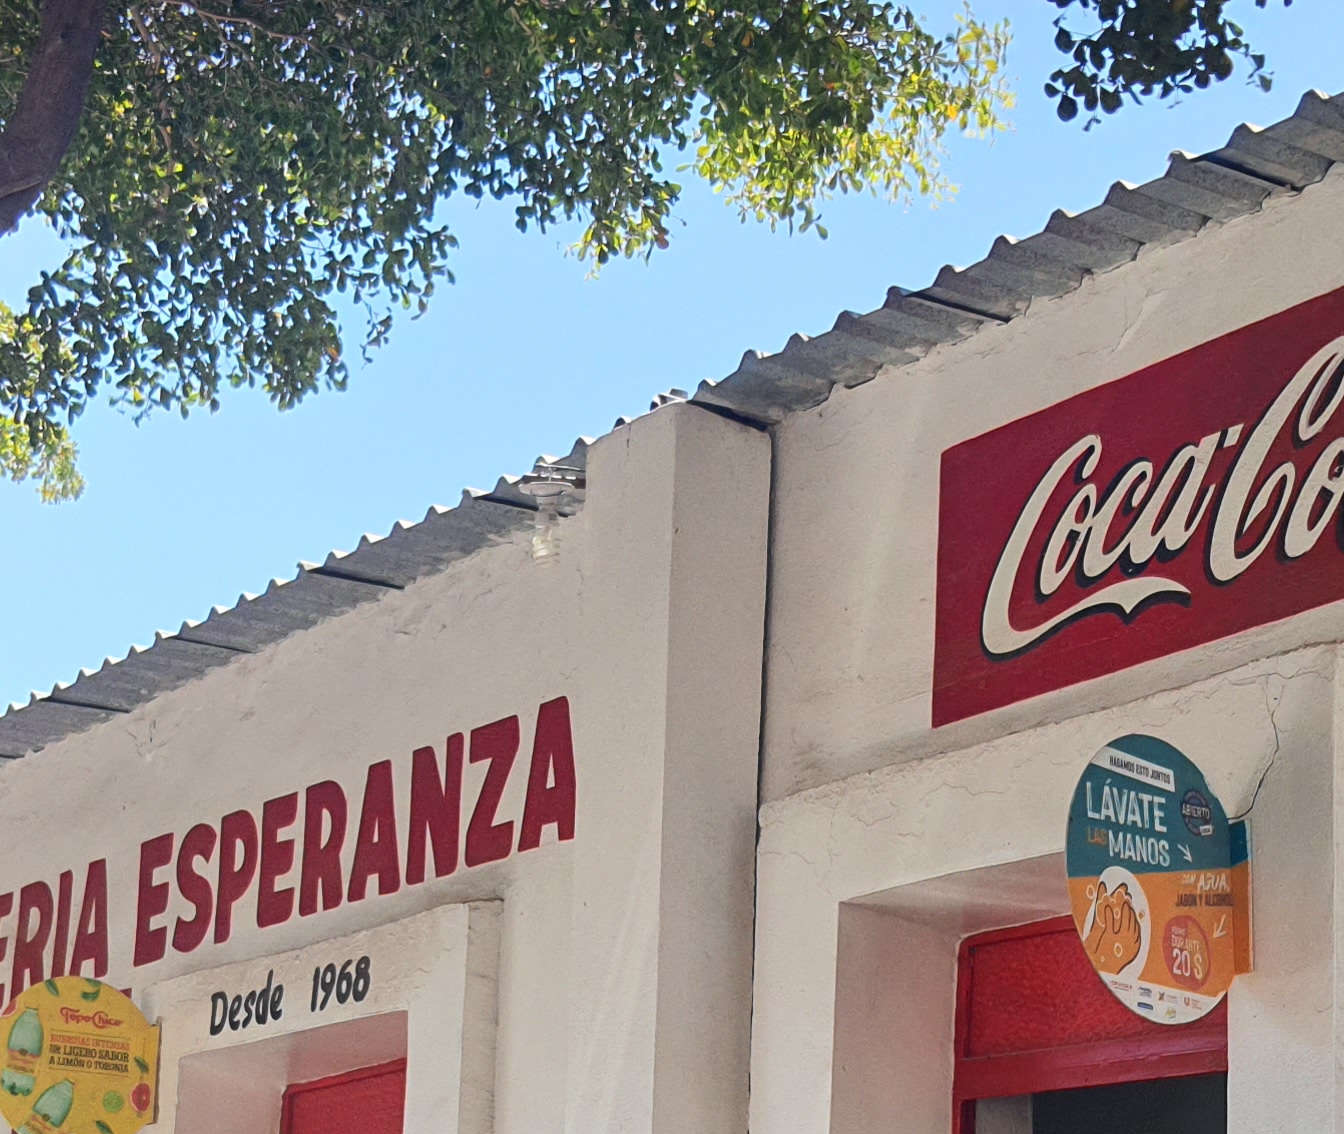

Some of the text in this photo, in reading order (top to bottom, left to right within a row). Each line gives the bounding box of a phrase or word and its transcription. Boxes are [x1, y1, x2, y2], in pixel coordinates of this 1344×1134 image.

[1109, 755, 1171, 785] HAGAMOS ESTO JUNTOS
[1086, 778, 1168, 833] LÁVATE
[1182, 803, 1211, 820] ABIERTO
[133, 697, 576, 967] ESPERANZA
[1087, 824, 1171, 867] LAS MANOS
[1171, 934, 1201, 952] DURANTE
[1172, 948, 1203, 980] 20 S
[209, 955, 372, 1038] Desde 1968
[49, 1055, 56, 1065] A
[63, 1045, 97, 1058] LIGERO
[98, 1048, 130, 1063] SABOR
